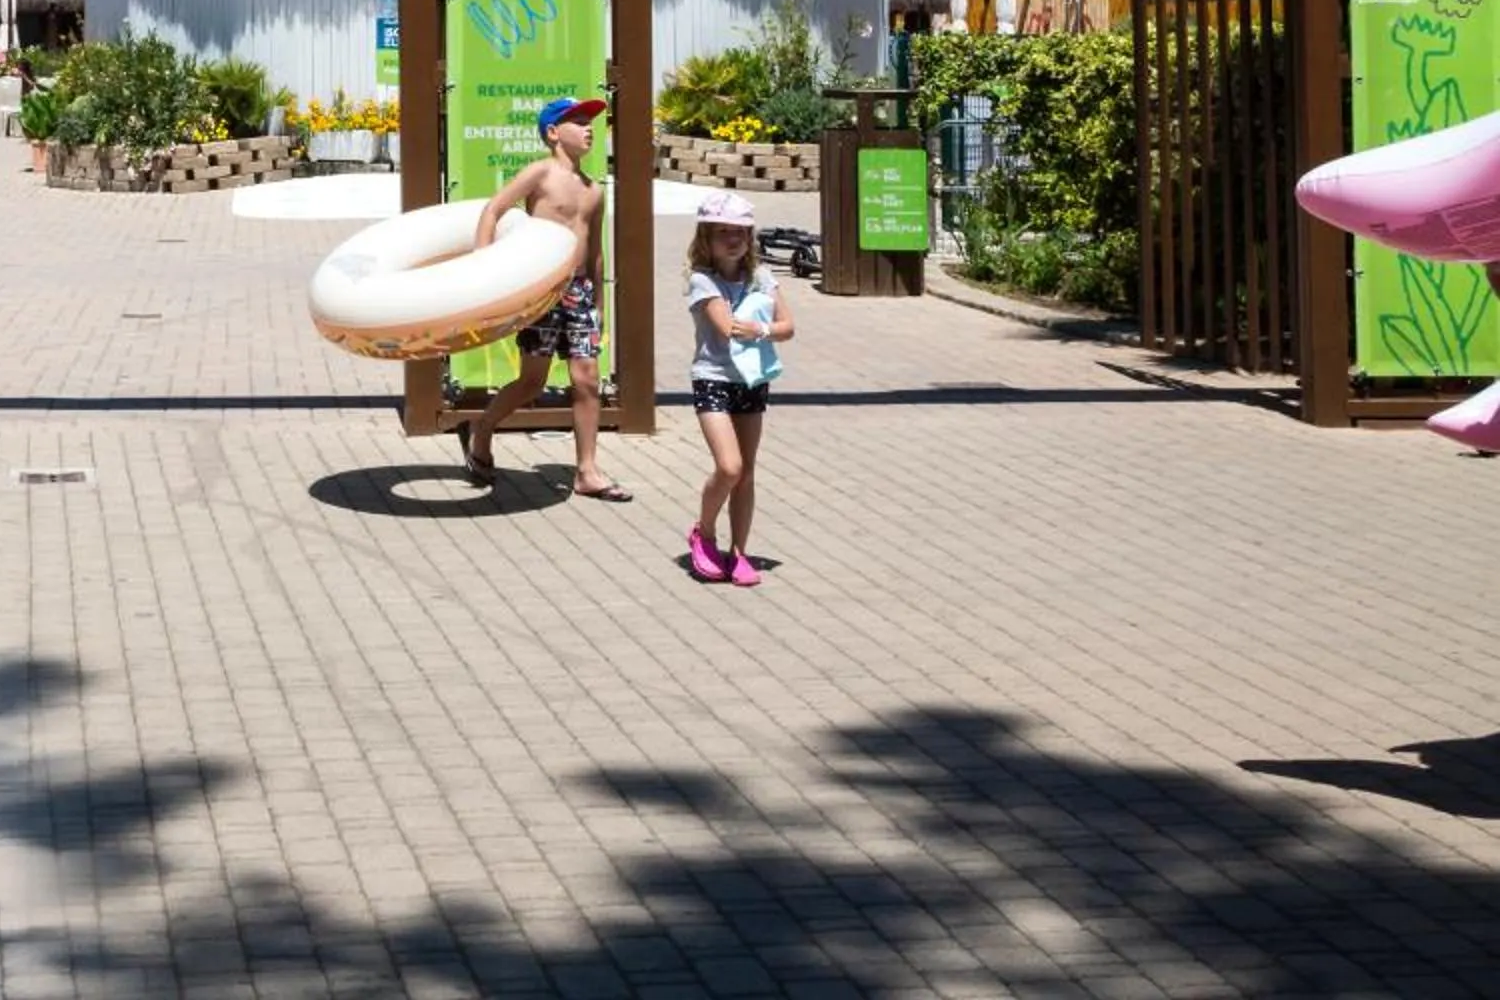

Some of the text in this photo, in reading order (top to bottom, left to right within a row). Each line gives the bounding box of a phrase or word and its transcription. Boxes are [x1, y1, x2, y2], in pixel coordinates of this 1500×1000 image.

[477, 84, 577, 96] RESTAURANT
[507, 111, 538, 124] SHO
[464, 126, 540, 139] ENTERTAI
